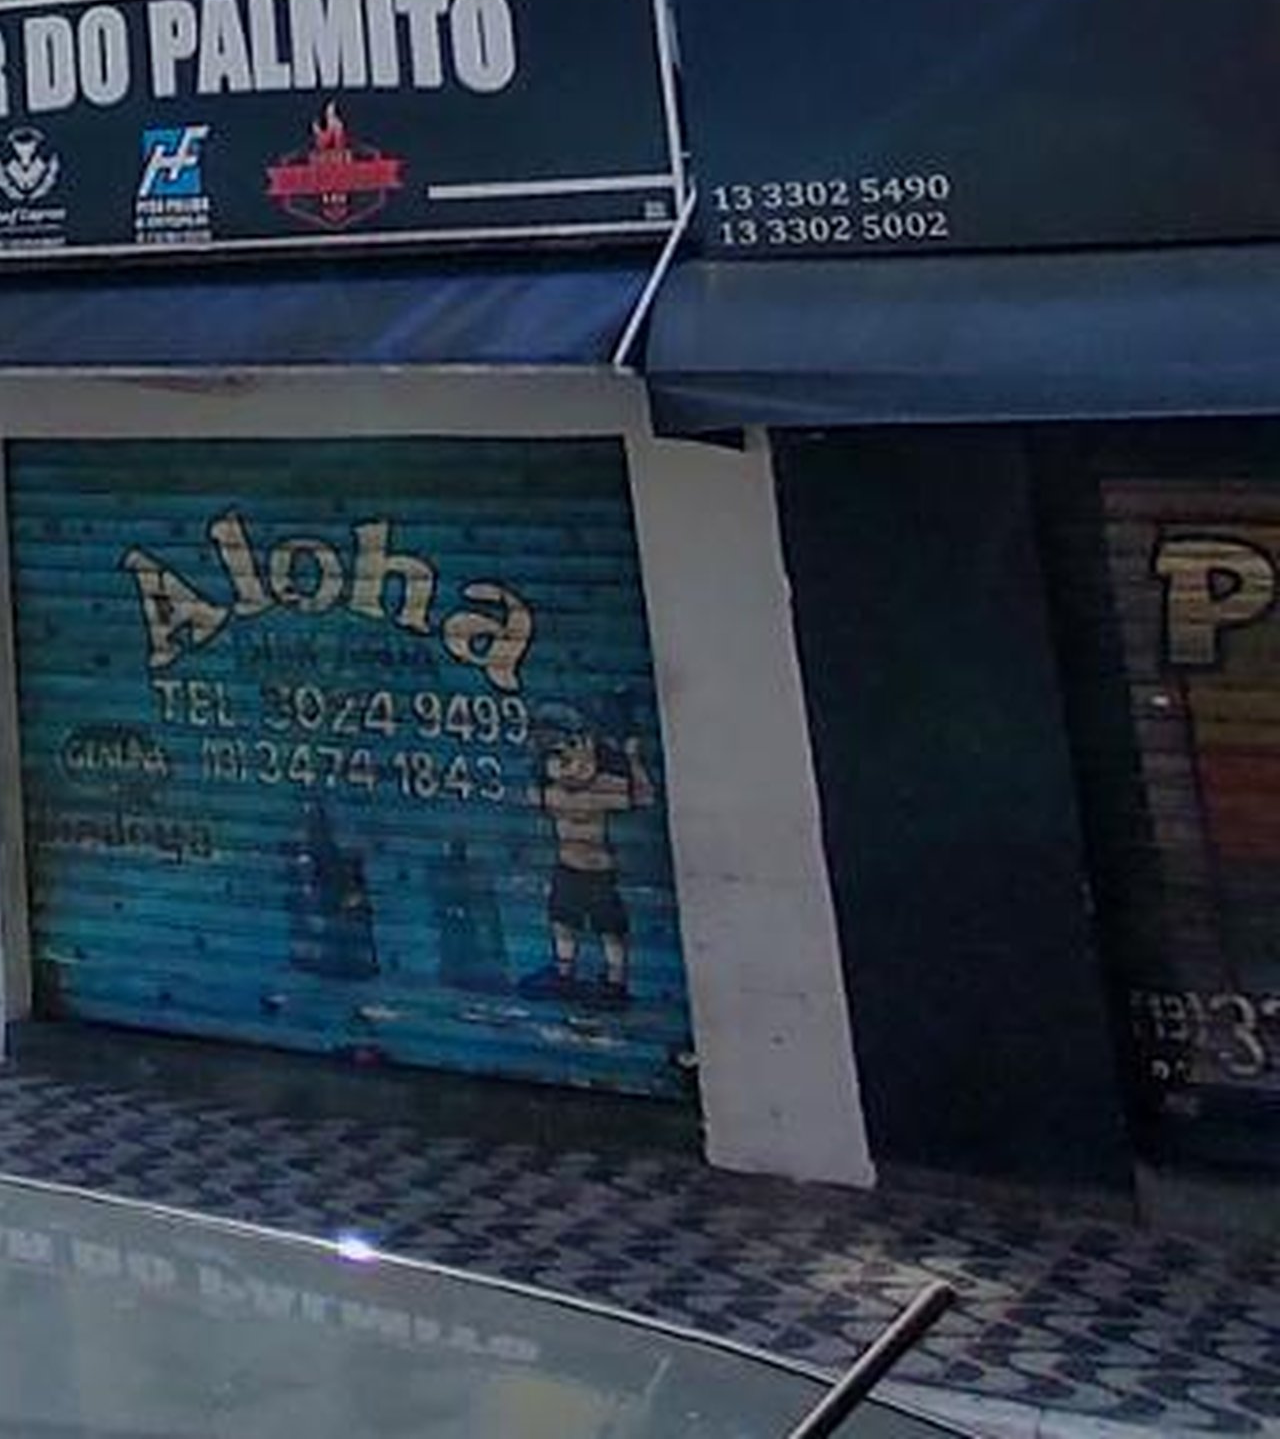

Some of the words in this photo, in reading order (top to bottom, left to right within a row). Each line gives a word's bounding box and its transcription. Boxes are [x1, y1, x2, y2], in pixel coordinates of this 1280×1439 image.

[23, 7, 131, 114] DO
[713, 185, 752, 211] 13
[761, 181, 850, 208] 3302
[860, 174, 950, 204] 5490
[720, 221, 758, 245] 13
[770, 216, 851, 242] 3302
[862, 212, 948, 238] 5002
[120, 509, 534, 693] Aloha
